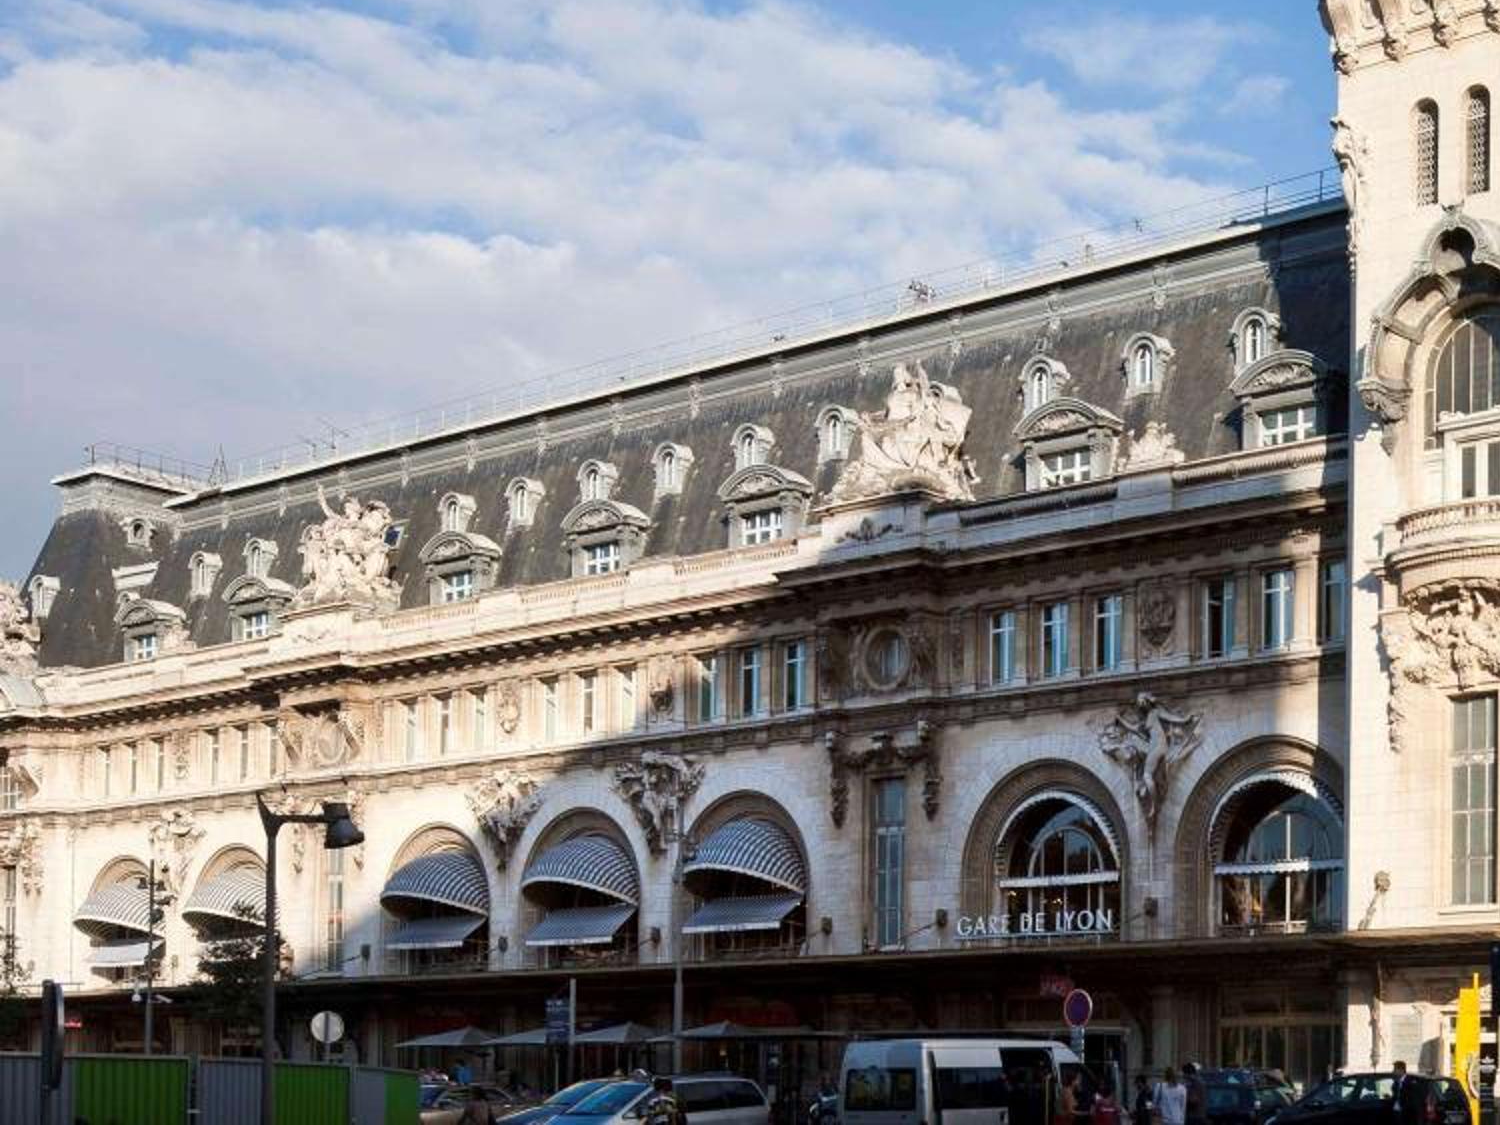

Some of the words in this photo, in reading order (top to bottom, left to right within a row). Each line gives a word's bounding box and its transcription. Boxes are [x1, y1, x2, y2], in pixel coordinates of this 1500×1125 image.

[956, 914, 1010, 937] GARE
[1020, 911, 1046, 932] DE
[1055, 908, 1113, 932] LYON
